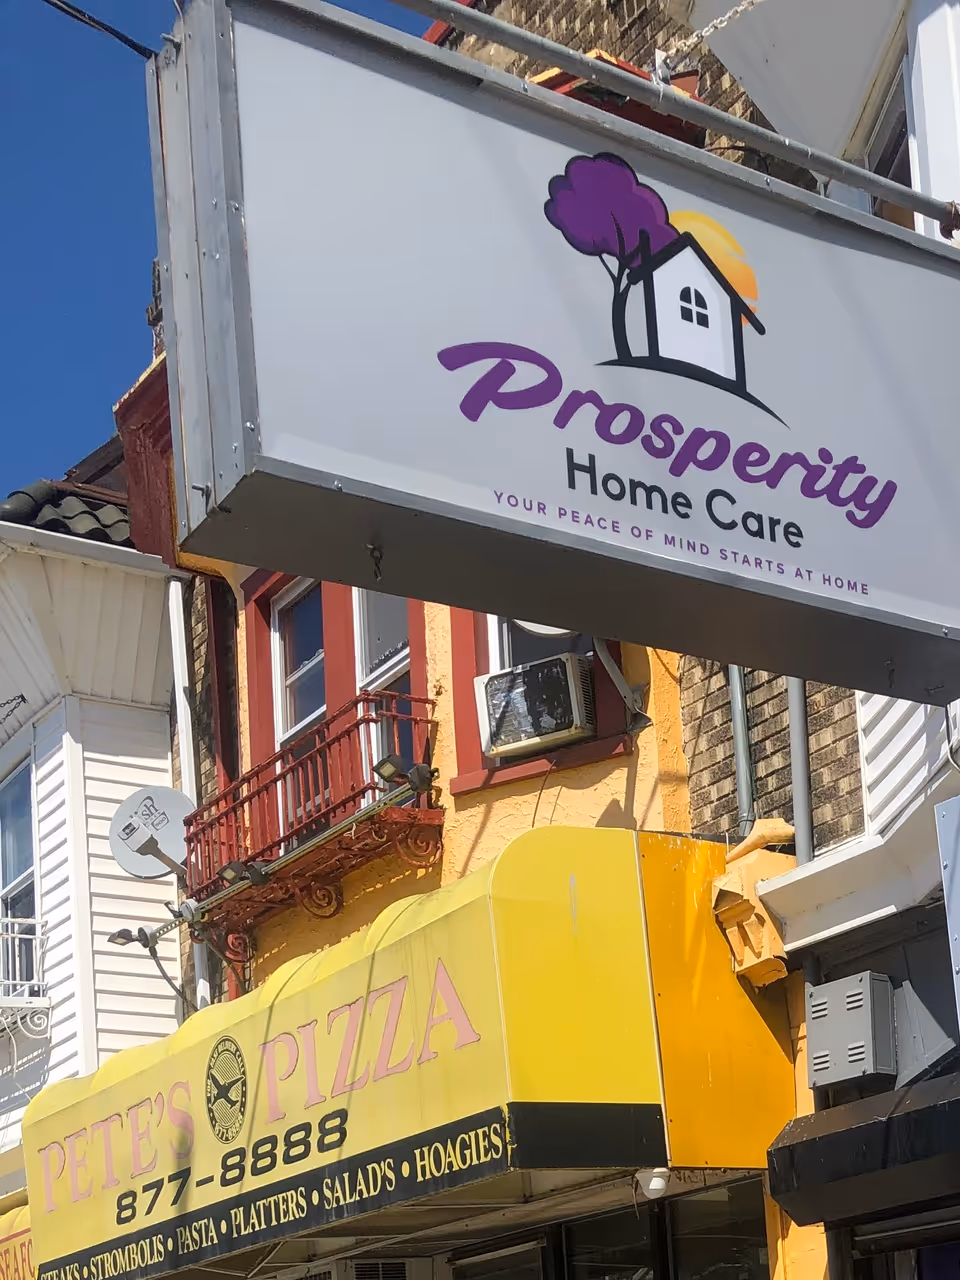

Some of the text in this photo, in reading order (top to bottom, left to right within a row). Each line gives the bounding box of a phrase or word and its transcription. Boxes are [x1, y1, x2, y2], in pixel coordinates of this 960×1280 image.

[437, 341, 897, 529] Prosperity
[494, 490, 869, 595] YOUR PEACE OF MIND STARTS AT HOME
[565, 447, 804, 548] Home Care
[38, 957, 481, 1214] PETE'S PIZZA
[116, 1108, 349, 1225] 877-8888
[176, 1217, 217, 1255] PASTA
[231, 1186, 307, 1238] PLATTERS
[323, 1158, 396, 1209] SALAD'S
[414, 1123, 503, 1182] HOAGIES
